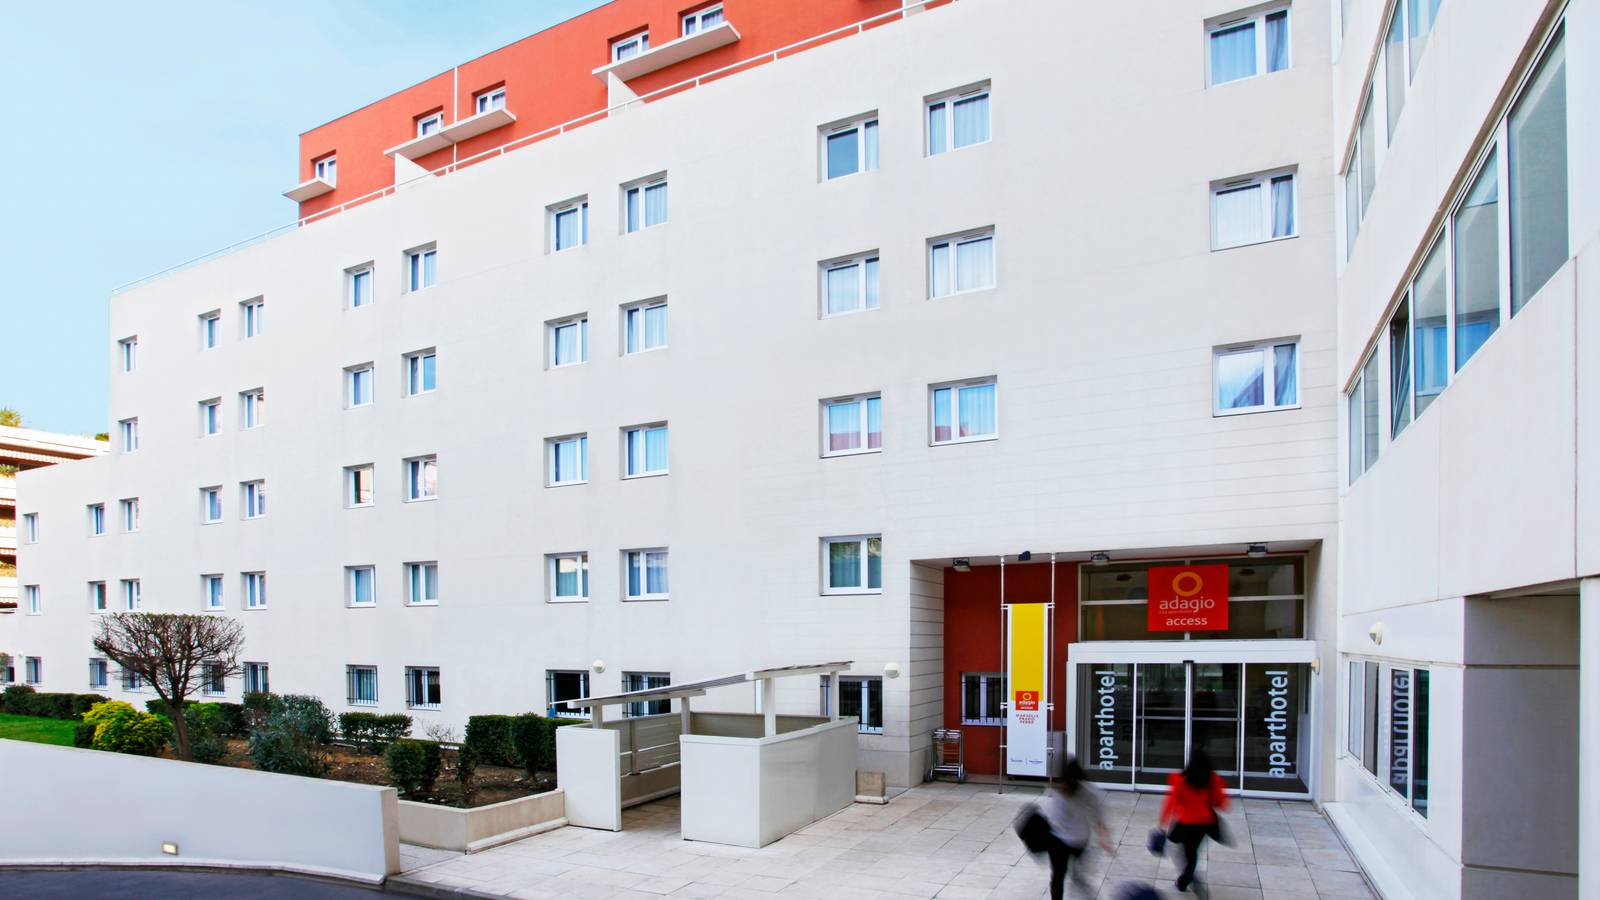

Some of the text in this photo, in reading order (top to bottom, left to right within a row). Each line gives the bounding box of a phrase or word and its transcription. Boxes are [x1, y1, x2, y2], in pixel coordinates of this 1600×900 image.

[1160, 596, 1215, 613] adagio
[1166, 617, 1208, 626] access
[1094, 670, 1118, 771] aparthotel
[1264, 670, 1291, 777] aparthotel
